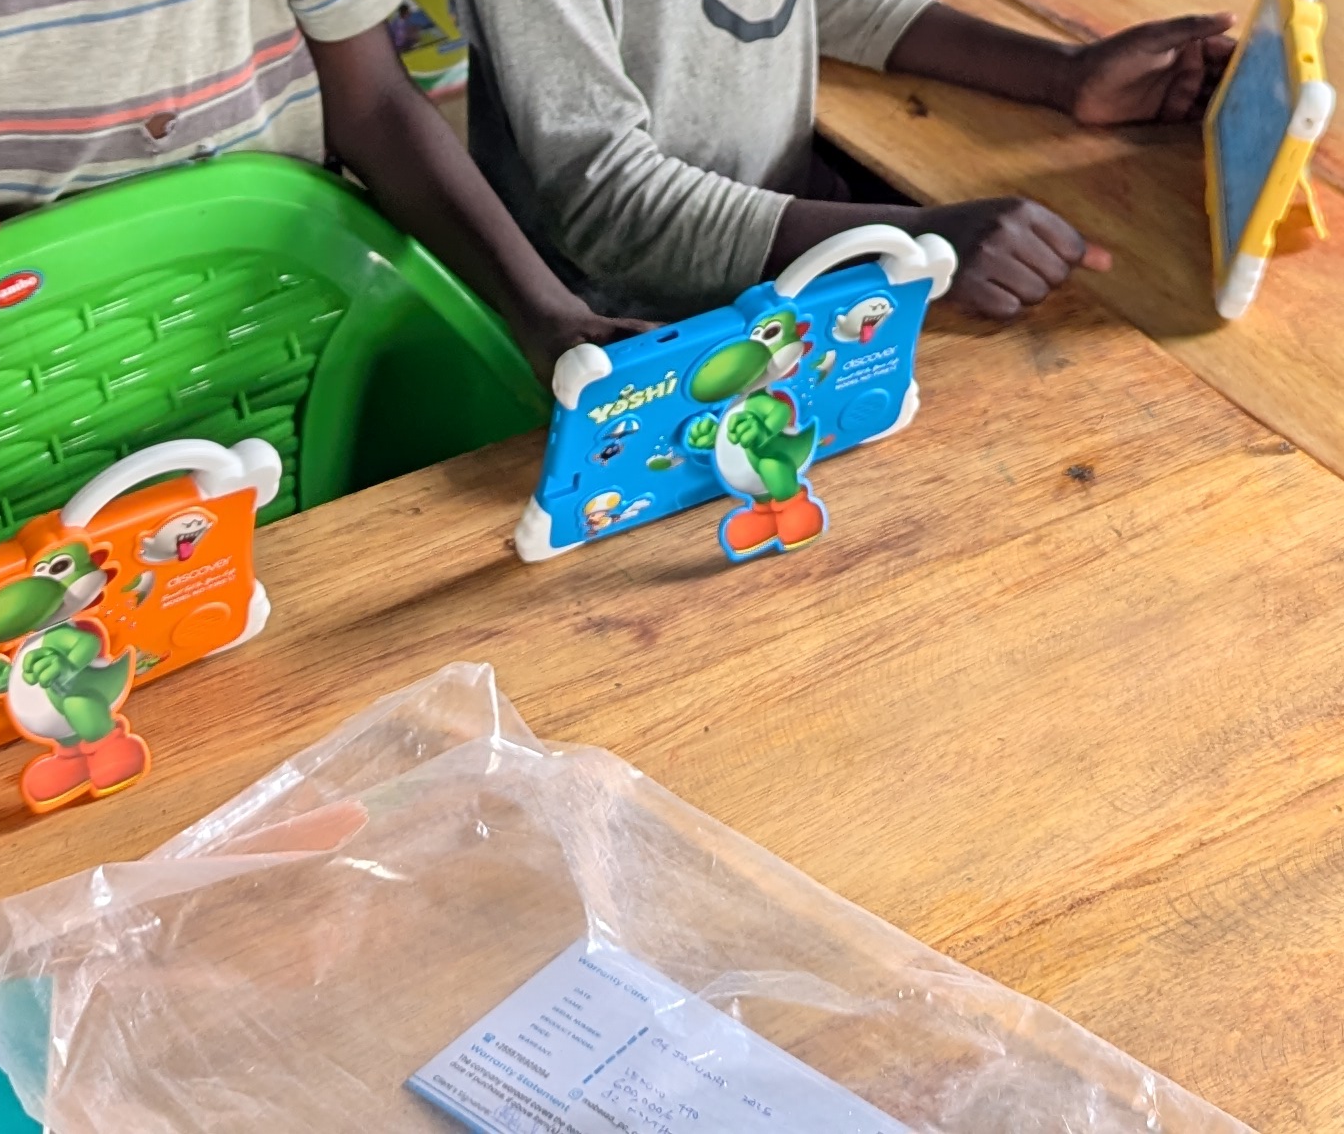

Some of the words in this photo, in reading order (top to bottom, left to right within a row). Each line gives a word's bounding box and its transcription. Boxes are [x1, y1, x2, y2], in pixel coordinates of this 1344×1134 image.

[587, 370, 678, 424] YOSHI
[578, 955, 623, 987] Warranty
[470, 1043, 516, 1077] Warranty
[516, 1072, 571, 1113] Statement
